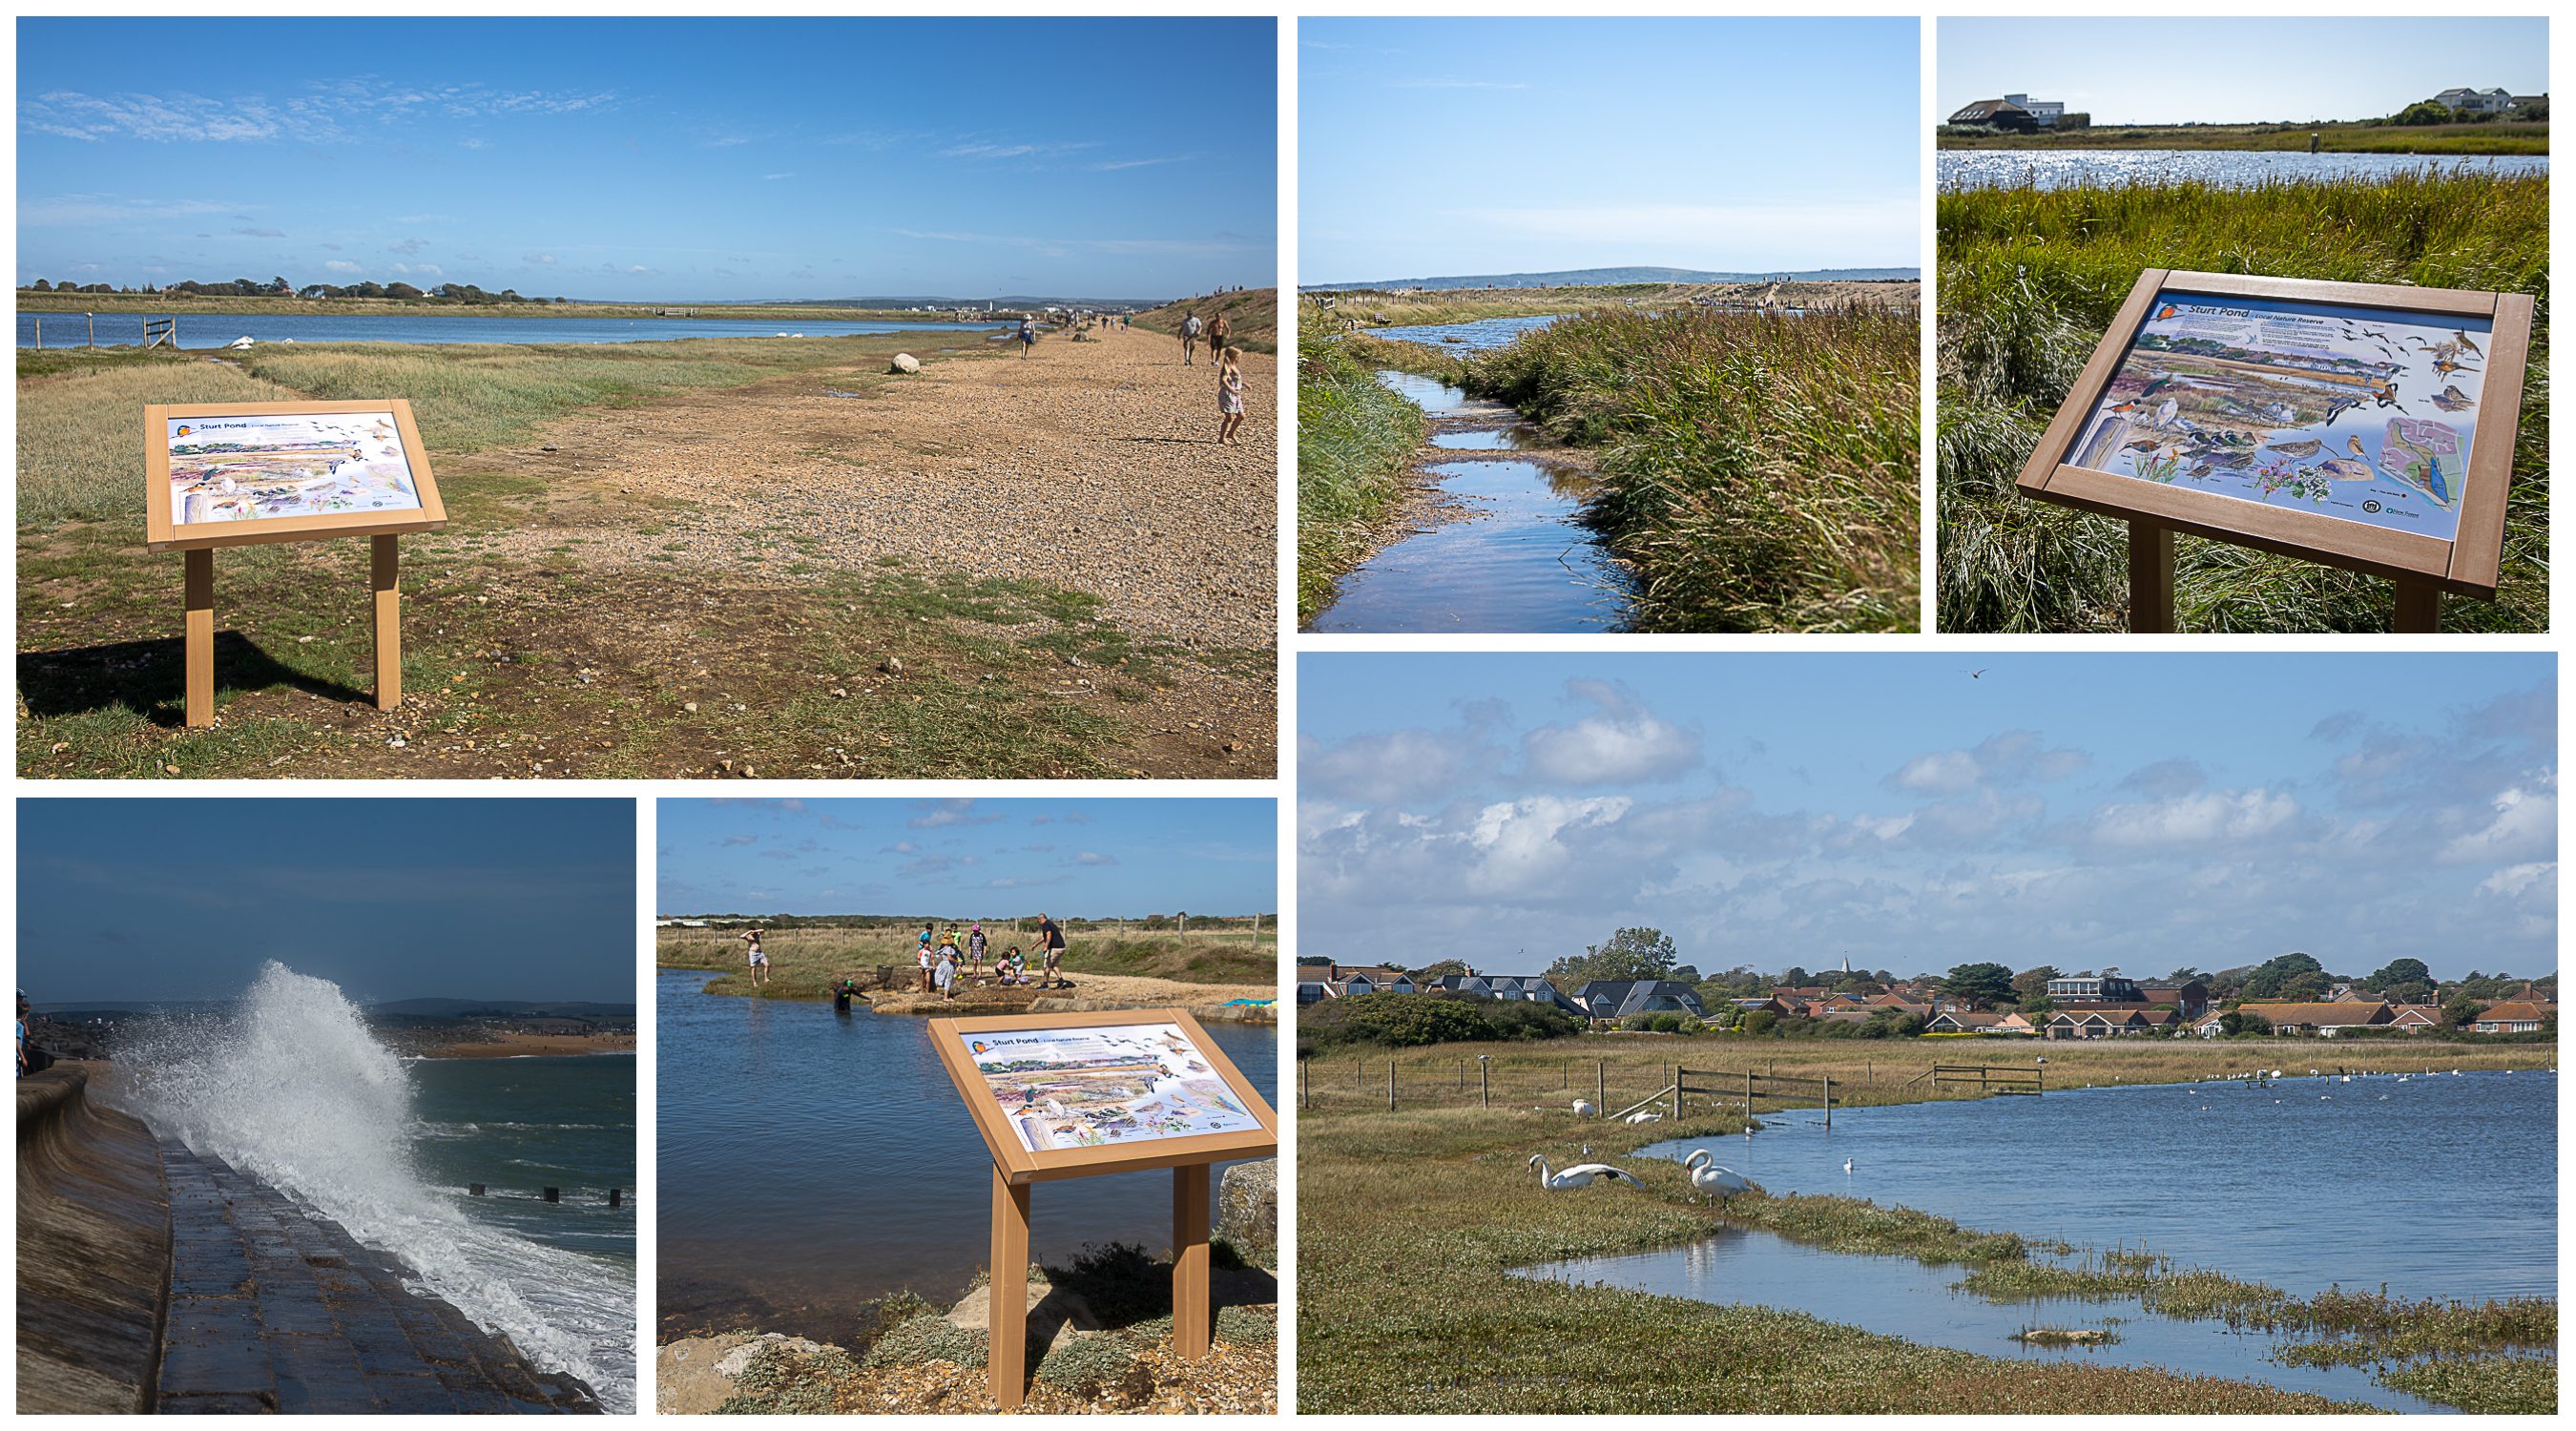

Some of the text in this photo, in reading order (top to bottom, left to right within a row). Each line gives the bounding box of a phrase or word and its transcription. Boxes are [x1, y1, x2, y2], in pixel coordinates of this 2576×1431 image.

[2189, 305, 2216, 315] Sturt
[2219, 307, 2250, 318] Pond
[2297, 317, 2324, 325] Reserve
